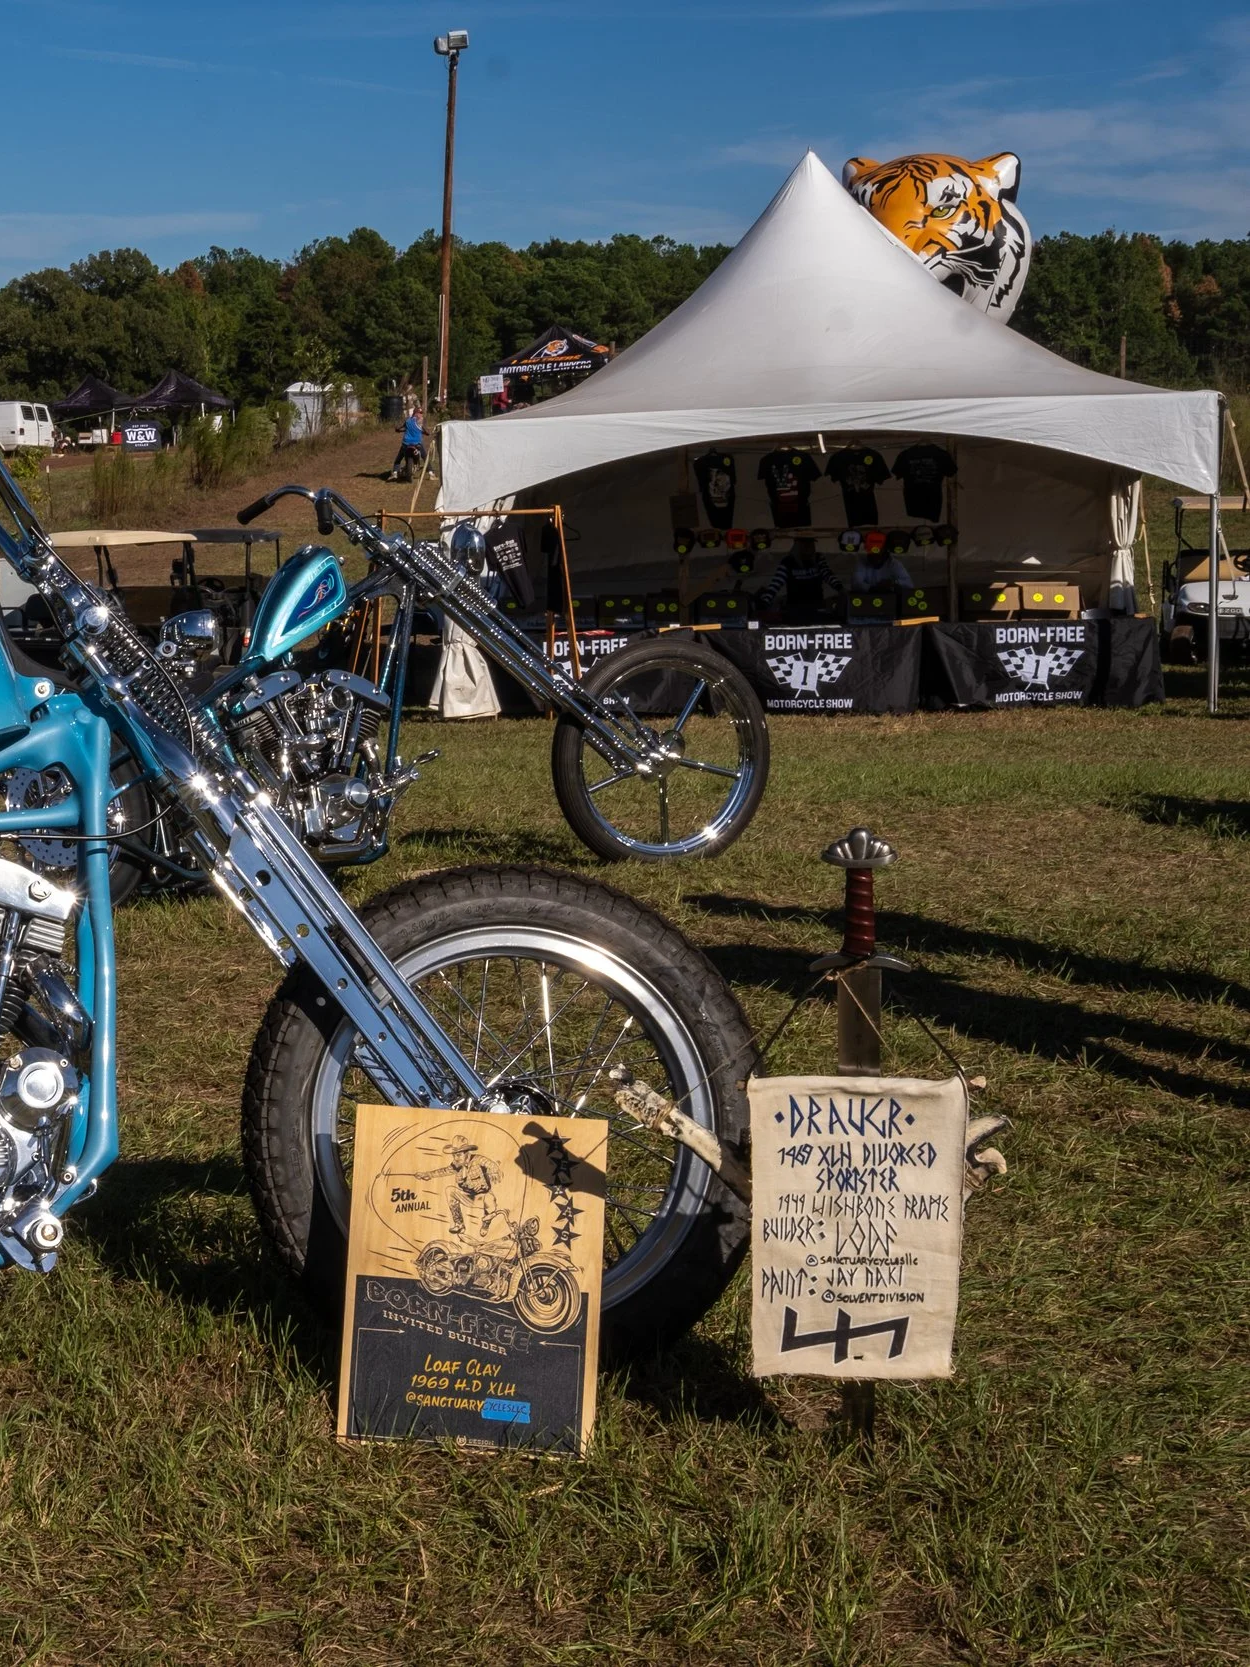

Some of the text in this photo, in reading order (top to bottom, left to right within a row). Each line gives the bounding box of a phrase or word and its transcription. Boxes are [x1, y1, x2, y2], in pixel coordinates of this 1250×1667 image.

[126, 430, 155, 441] W&W
[765, 633, 852, 651] BORN-FREE
[996, 626, 1085, 644] BORN-FREE
[767, 698, 853, 709] MOTORCYCLE SHOW
[995, 690, 1083, 704] MOTORCYCLE SHOW
[789, 1094, 903, 1139] DRAUGR
[816, 1166, 900, 1194] SPORTSTER
[390, 1187, 417, 1203] 5th
[395, 1200, 431, 1214] ANNUAL
[778, 1195, 806, 1214] 1949
[762, 1216, 826, 1247] BUILDER:
[821, 1289, 924, 1304] @SOLVENTDIVISION
[366, 1280, 532, 1352] BORN-FREE
[383, 1309, 507, 1356] INVITED BUILDER
[424, 1354, 501, 1377] LOAF CLAY
[410, 1374, 516, 1397] 1969 H-D XLH
